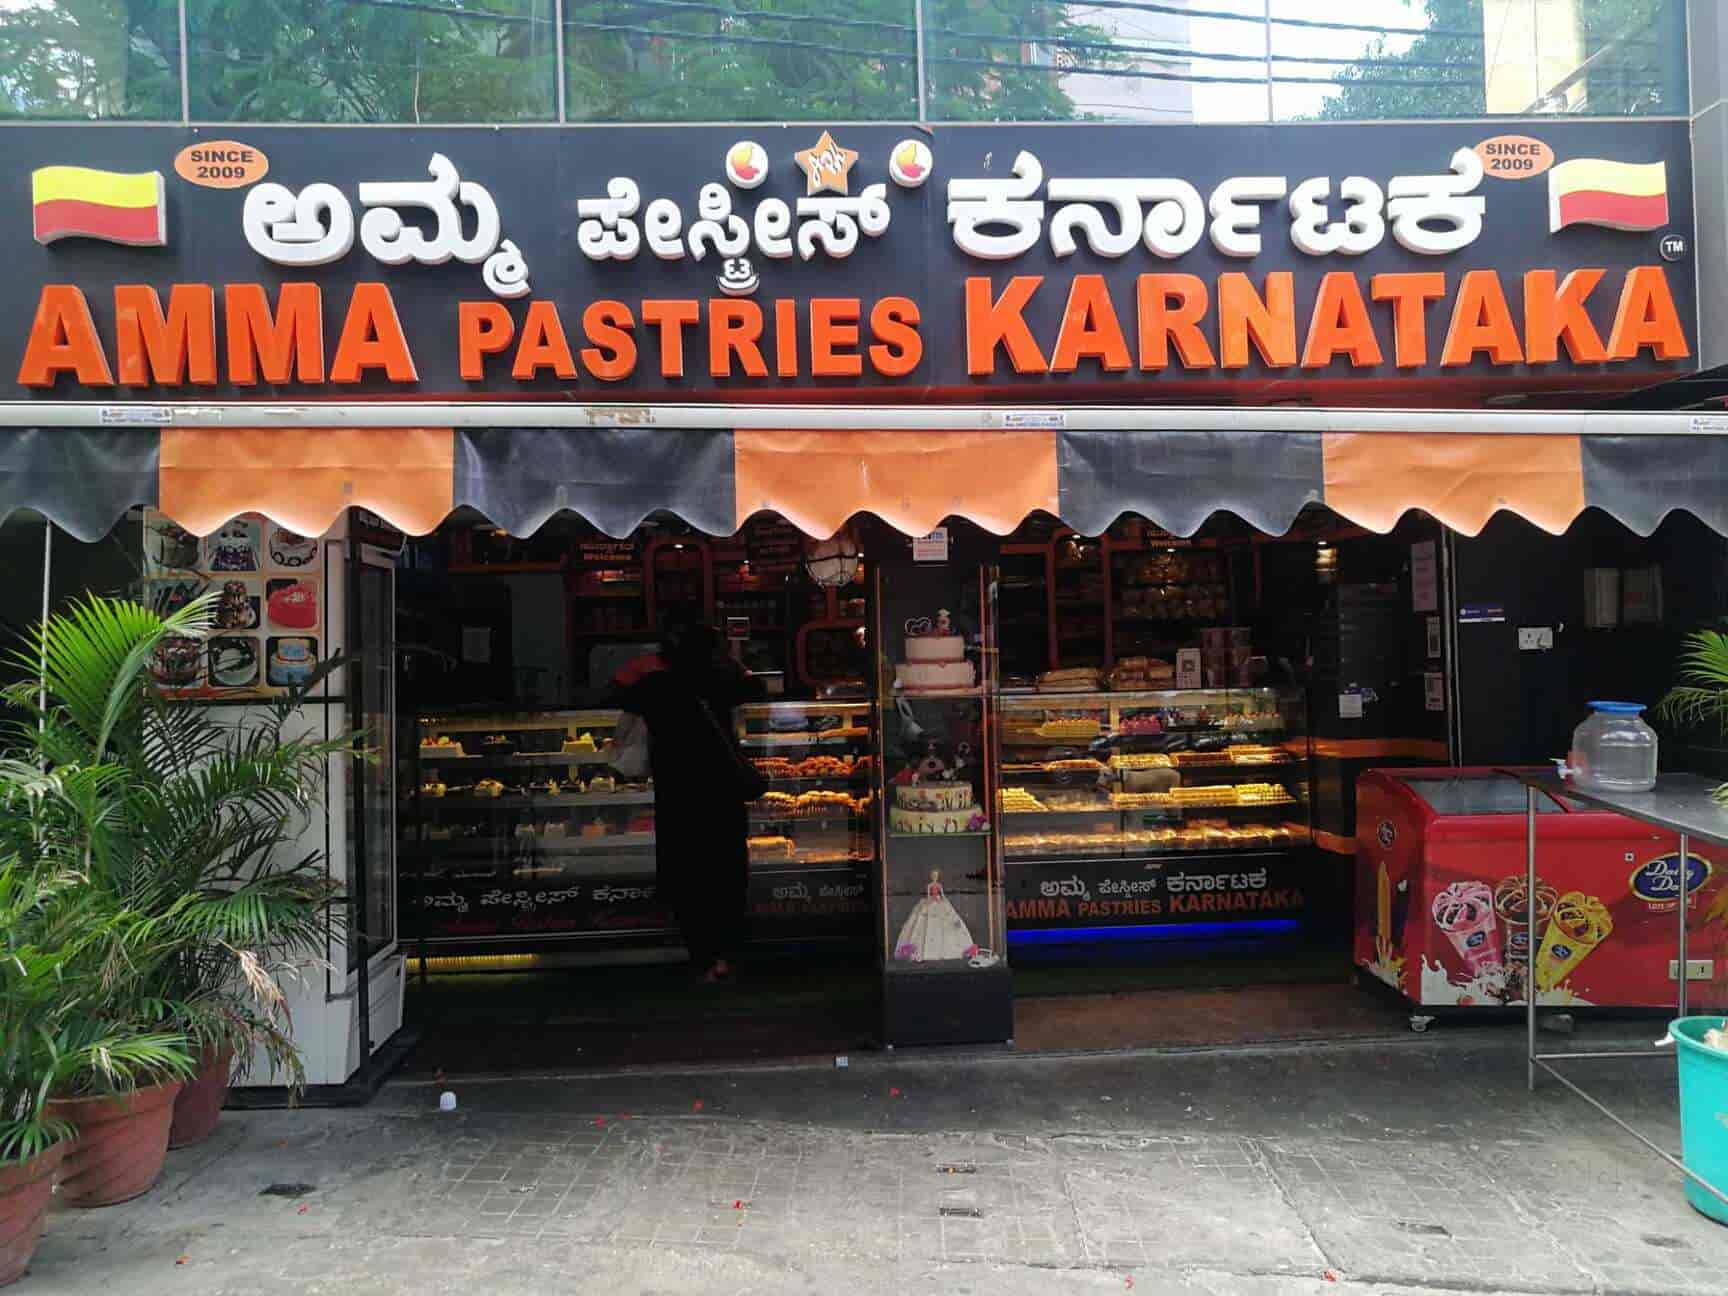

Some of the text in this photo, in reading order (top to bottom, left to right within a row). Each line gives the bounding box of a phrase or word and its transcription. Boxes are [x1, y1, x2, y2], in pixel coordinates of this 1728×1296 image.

[191, 150, 254, 163] SINCE
[1486, 143, 1541, 156] SINCE
[1491, 158, 1534, 170] 2009
[197, 166, 245, 178] 2009
[243, 147, 1486, 298] ಅಮ್ಮ ಪೇಸ್ಟ್ರೀಸ್ ಕರ್ನಾಟಕ
[1664, 240, 1684, 252] TM
[17, 266, 1690, 387] AMMA PASTRIES KARNATAKA
[1645, 860, 1695, 880] Daiy
[1650, 875, 1686, 891] Da
[1006, 899, 1072, 919] AMMA
[1078, 898, 1161, 917] PASTRIES
